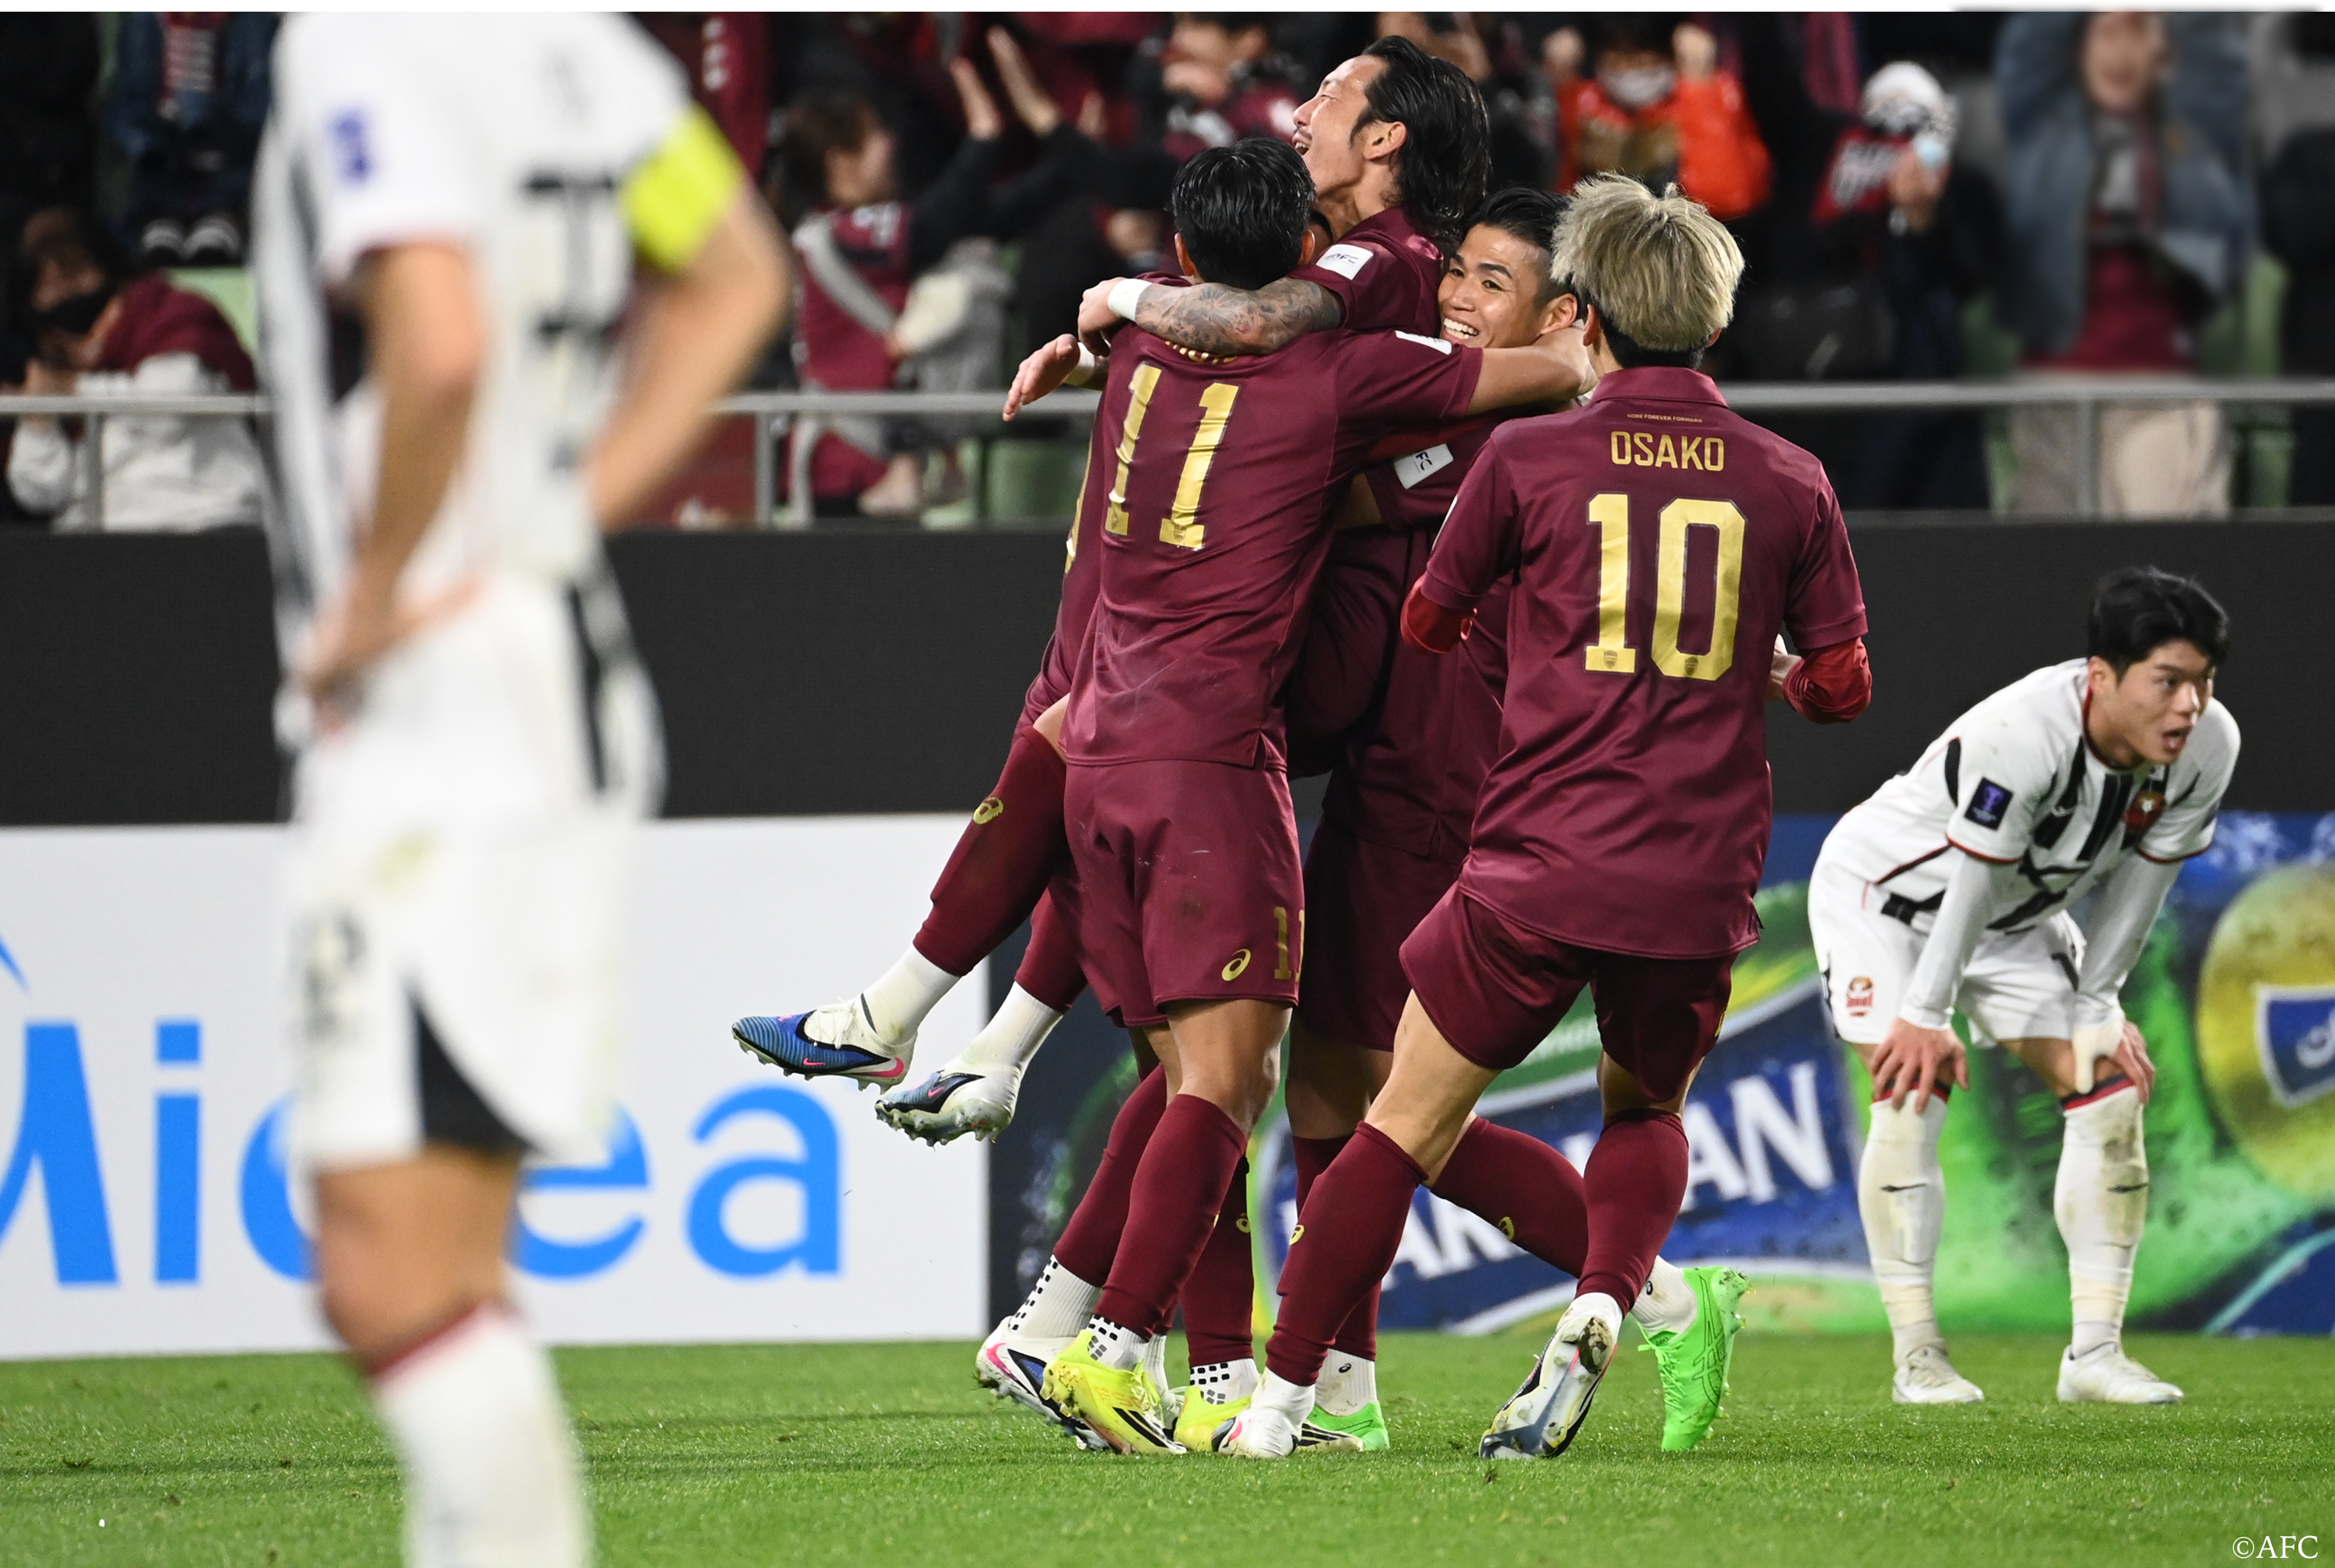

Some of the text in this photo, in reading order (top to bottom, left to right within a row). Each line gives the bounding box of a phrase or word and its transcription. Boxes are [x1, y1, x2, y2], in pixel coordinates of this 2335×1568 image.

[1326, 253, 1359, 265] AFC
[1104, 363, 1240, 549] 11
[1415, 451, 1433, 471] FC
[1610, 430, 1725, 472] OSAKO
[1585, 493, 1747, 682] 10
